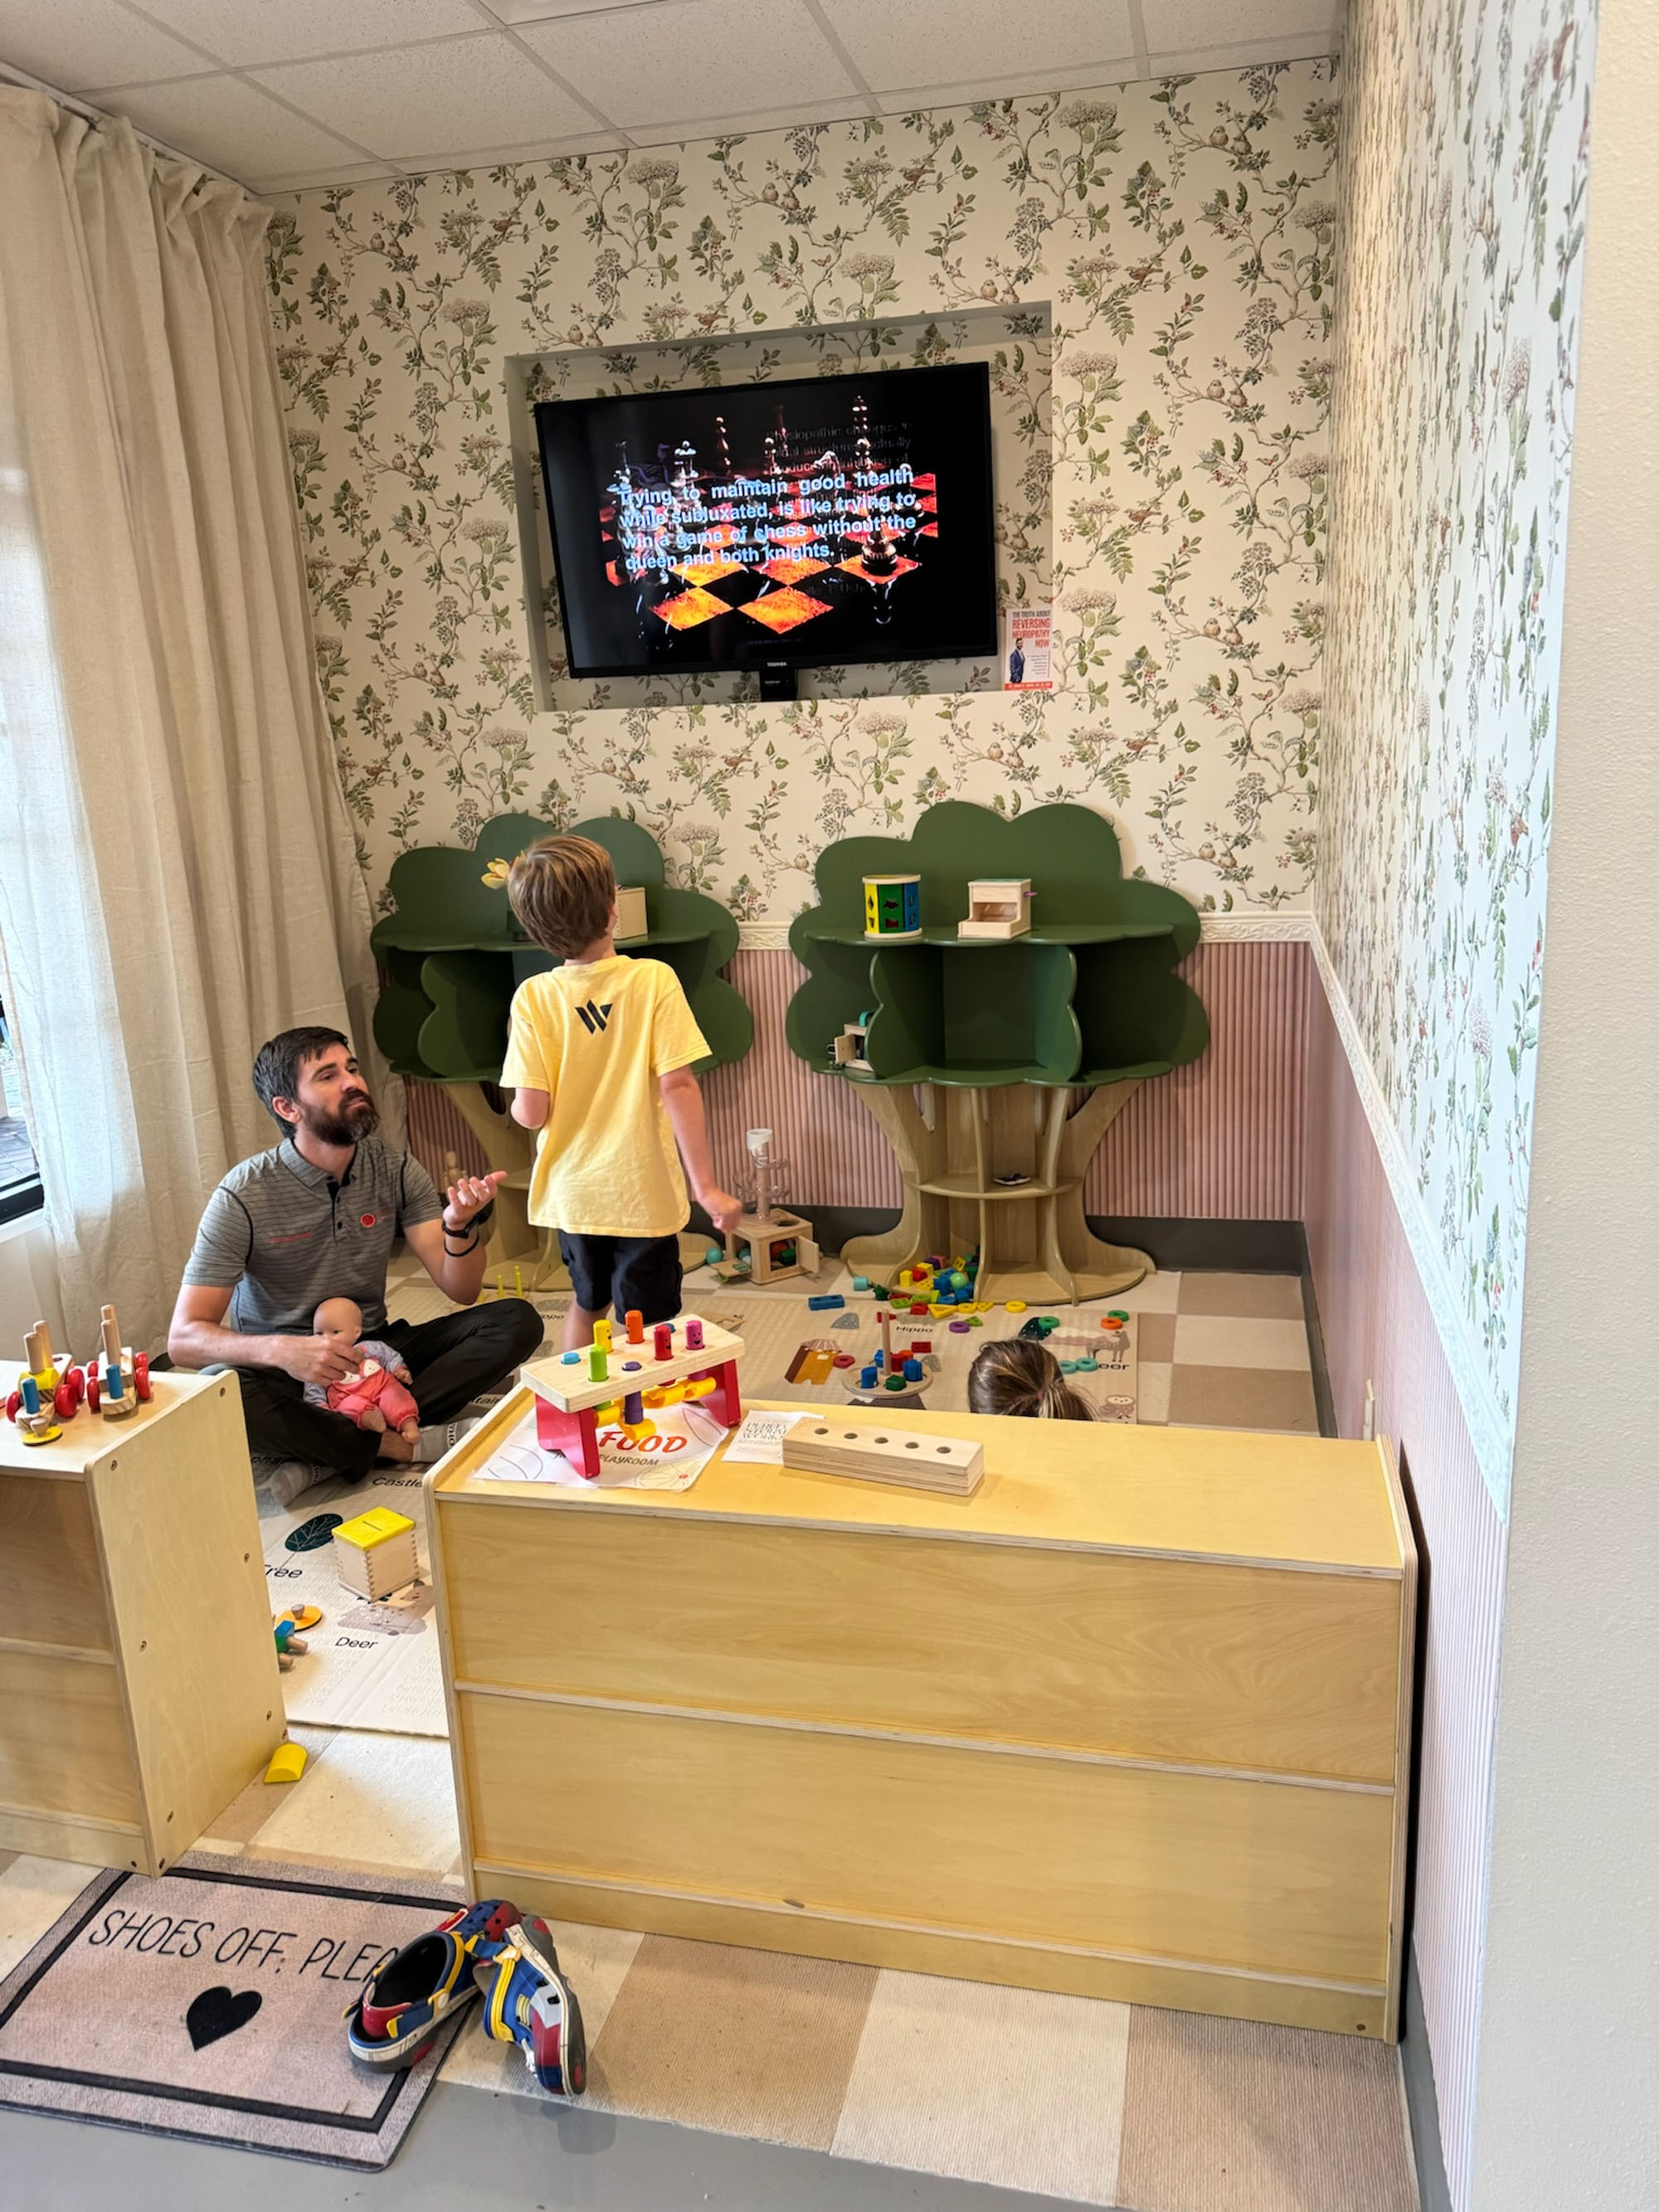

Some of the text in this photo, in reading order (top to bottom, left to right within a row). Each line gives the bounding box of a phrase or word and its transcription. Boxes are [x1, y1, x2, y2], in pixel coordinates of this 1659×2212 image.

[620, 467, 913, 508] Trying to maintain good health
[620, 491, 916, 527] while subluxated, is like trying to
[622, 513, 916, 549] win a game of chess without the
[625, 542, 834, 573] queen and both knights.
[1012, 617, 1050, 630] REVERSING
[896, 1325, 933, 1334] Hippo
[599, 1431, 688, 1453] FOOD
[372, 1476, 423, 1488] Castle
[334, 1636, 379, 1649] Deer
[89, 1909, 215, 1958] SHOES
